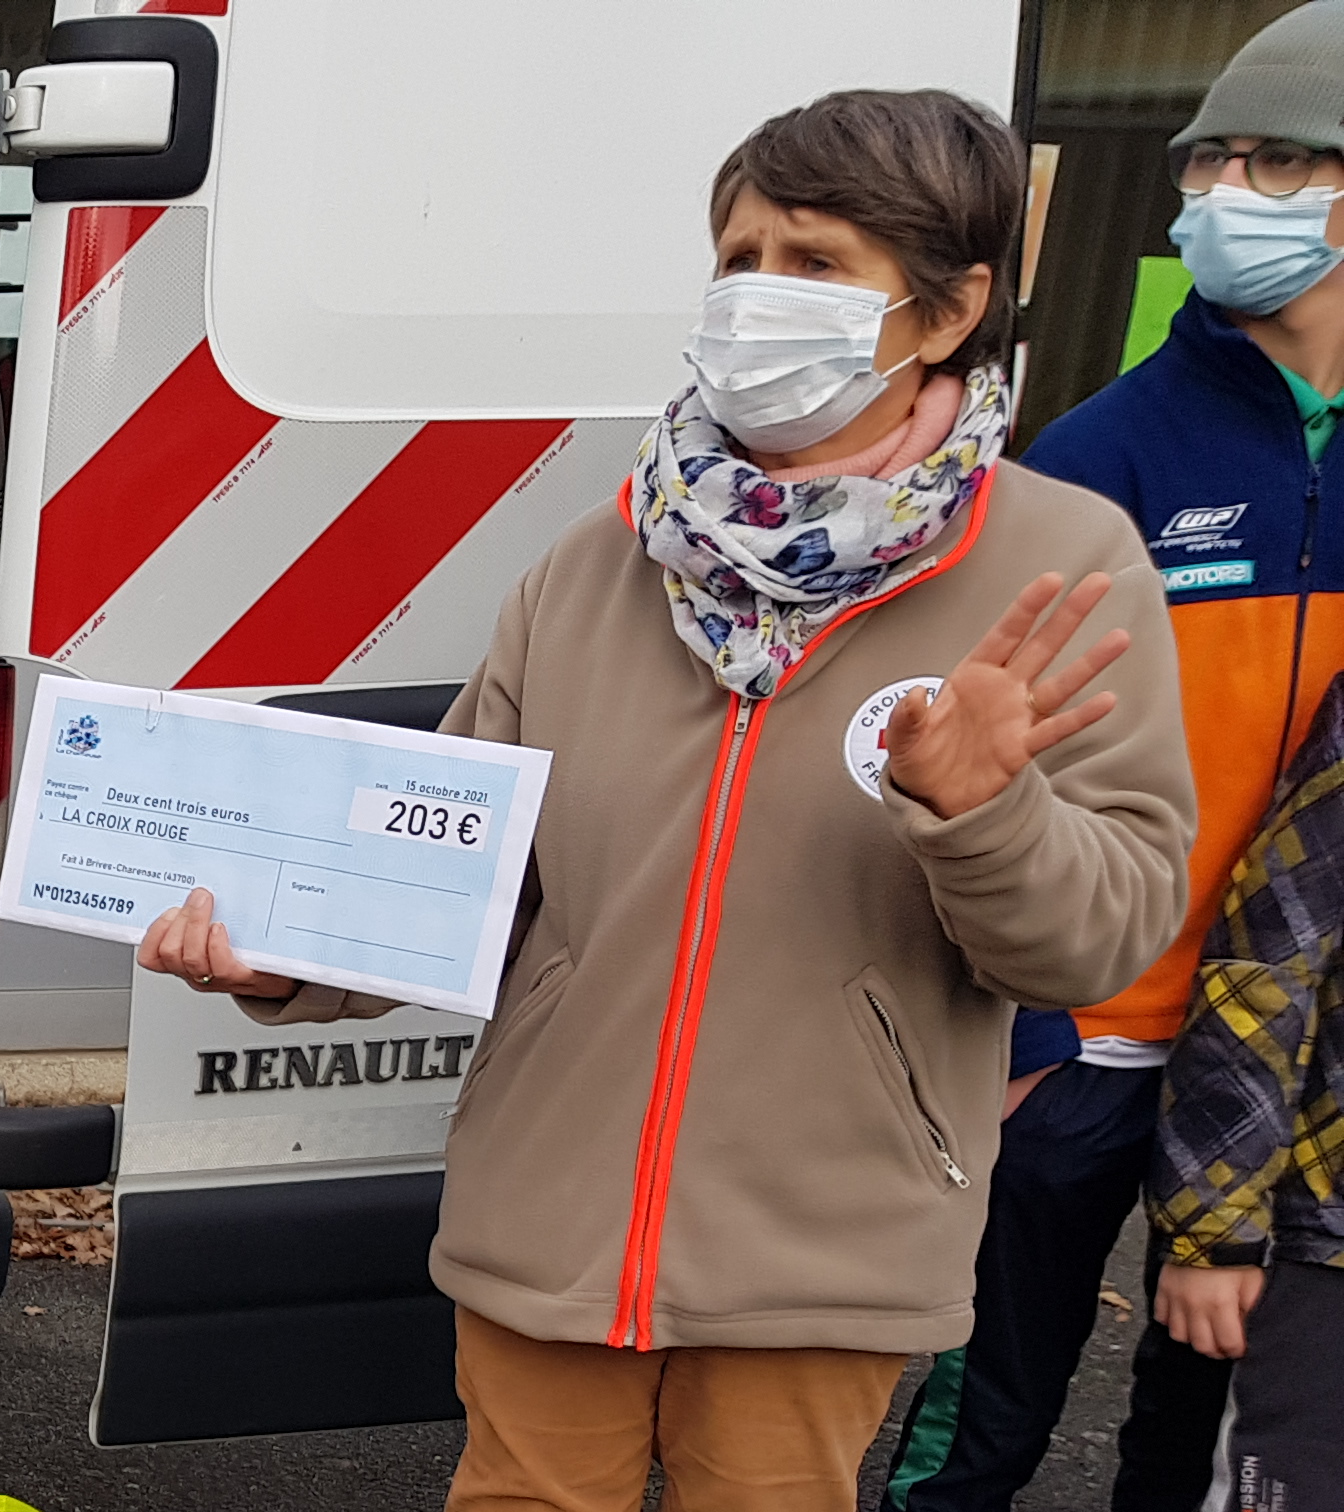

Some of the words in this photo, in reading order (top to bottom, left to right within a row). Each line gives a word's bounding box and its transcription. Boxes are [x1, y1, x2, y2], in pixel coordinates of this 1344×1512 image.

[107, 787, 140, 805] Deux
[144, 793, 172, 810] cent
[176, 799, 207, 816] trois
[211, 807, 250, 824] euros
[405, 779, 416, 791] 15
[419, 783, 460, 799] octobre
[463, 789, 488, 803] 2021
[62, 806, 81, 823] LA
[86, 810, 132, 833] CROIX
[134, 818, 190, 842] ROUGE
[384, 800, 449, 840] 203
[457, 813, 481, 846] €
[62, 853, 77, 864] Fait
[78, 856, 84, 866] à
[85, 858, 162, 880] Brives-Charensac
[33, 883, 134, 914] N°0123456789
[194, 1032, 475, 1096] RENAULT
